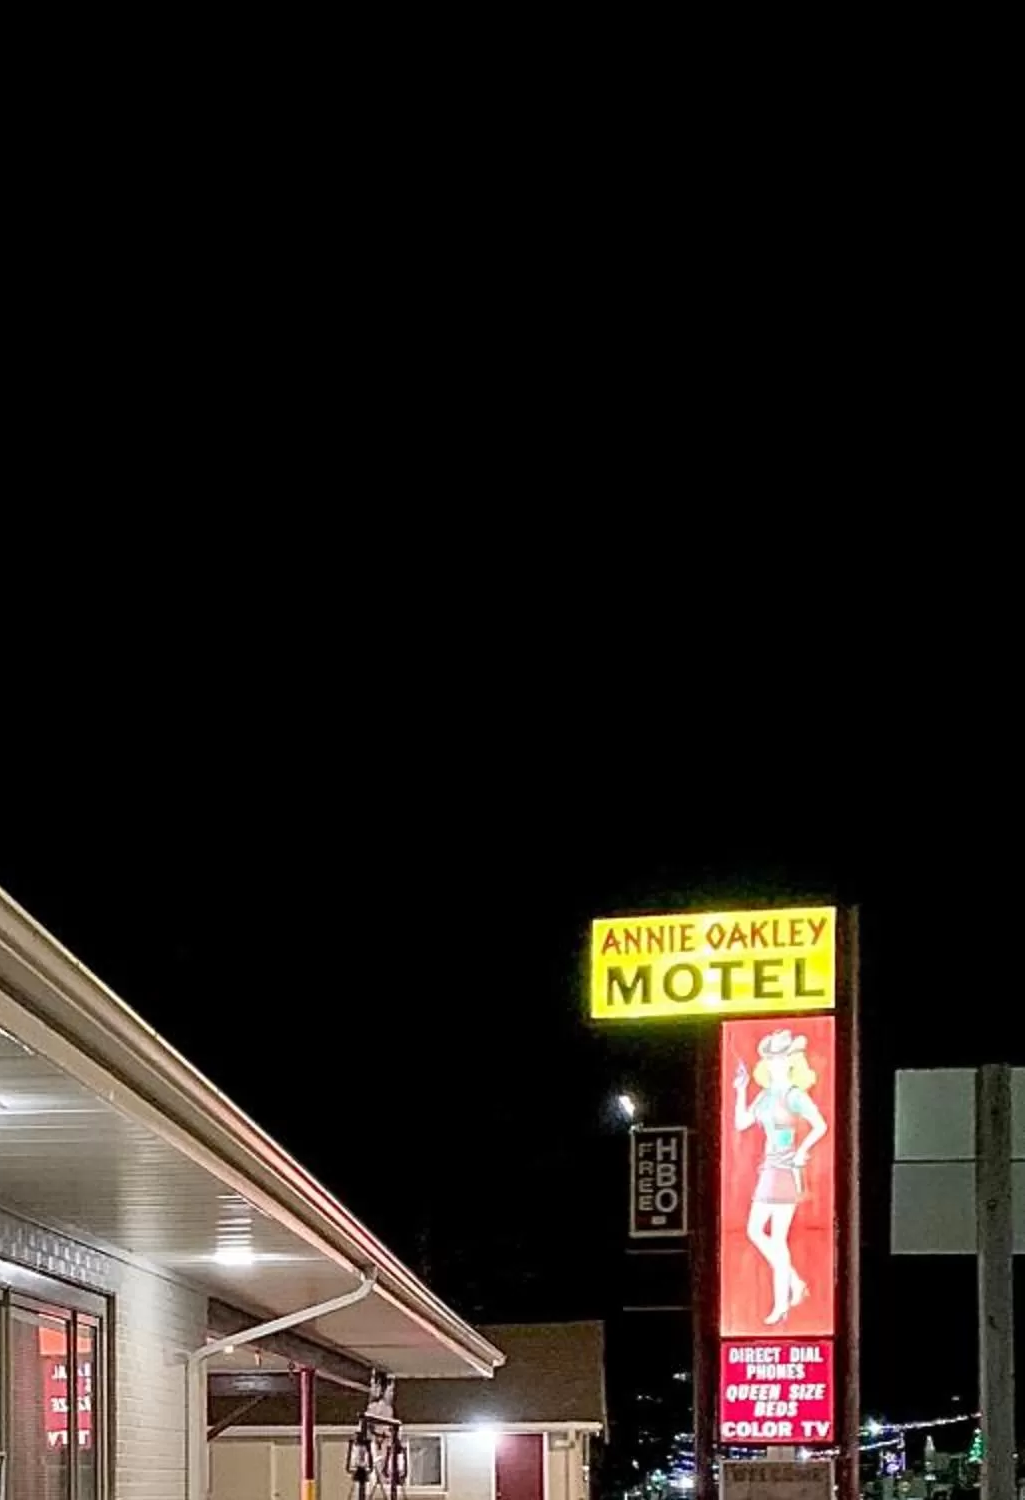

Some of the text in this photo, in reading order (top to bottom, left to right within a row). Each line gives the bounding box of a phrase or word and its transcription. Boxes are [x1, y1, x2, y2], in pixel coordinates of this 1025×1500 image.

[601, 917, 827, 956] ANNIE OAKLEY
[607, 957, 825, 1006] MOTEL
[638, 1142, 654, 1211] FREE
[655, 1137, 678, 1213] HBO
[729, 1346, 823, 1363] DIRECT DIAL
[746, 1363, 805, 1380] PHONES
[726, 1383, 826, 1402] QUEEN SIZE
[754, 1401, 798, 1417] BEDS
[721, 1421, 830, 1438] COLOR TV
